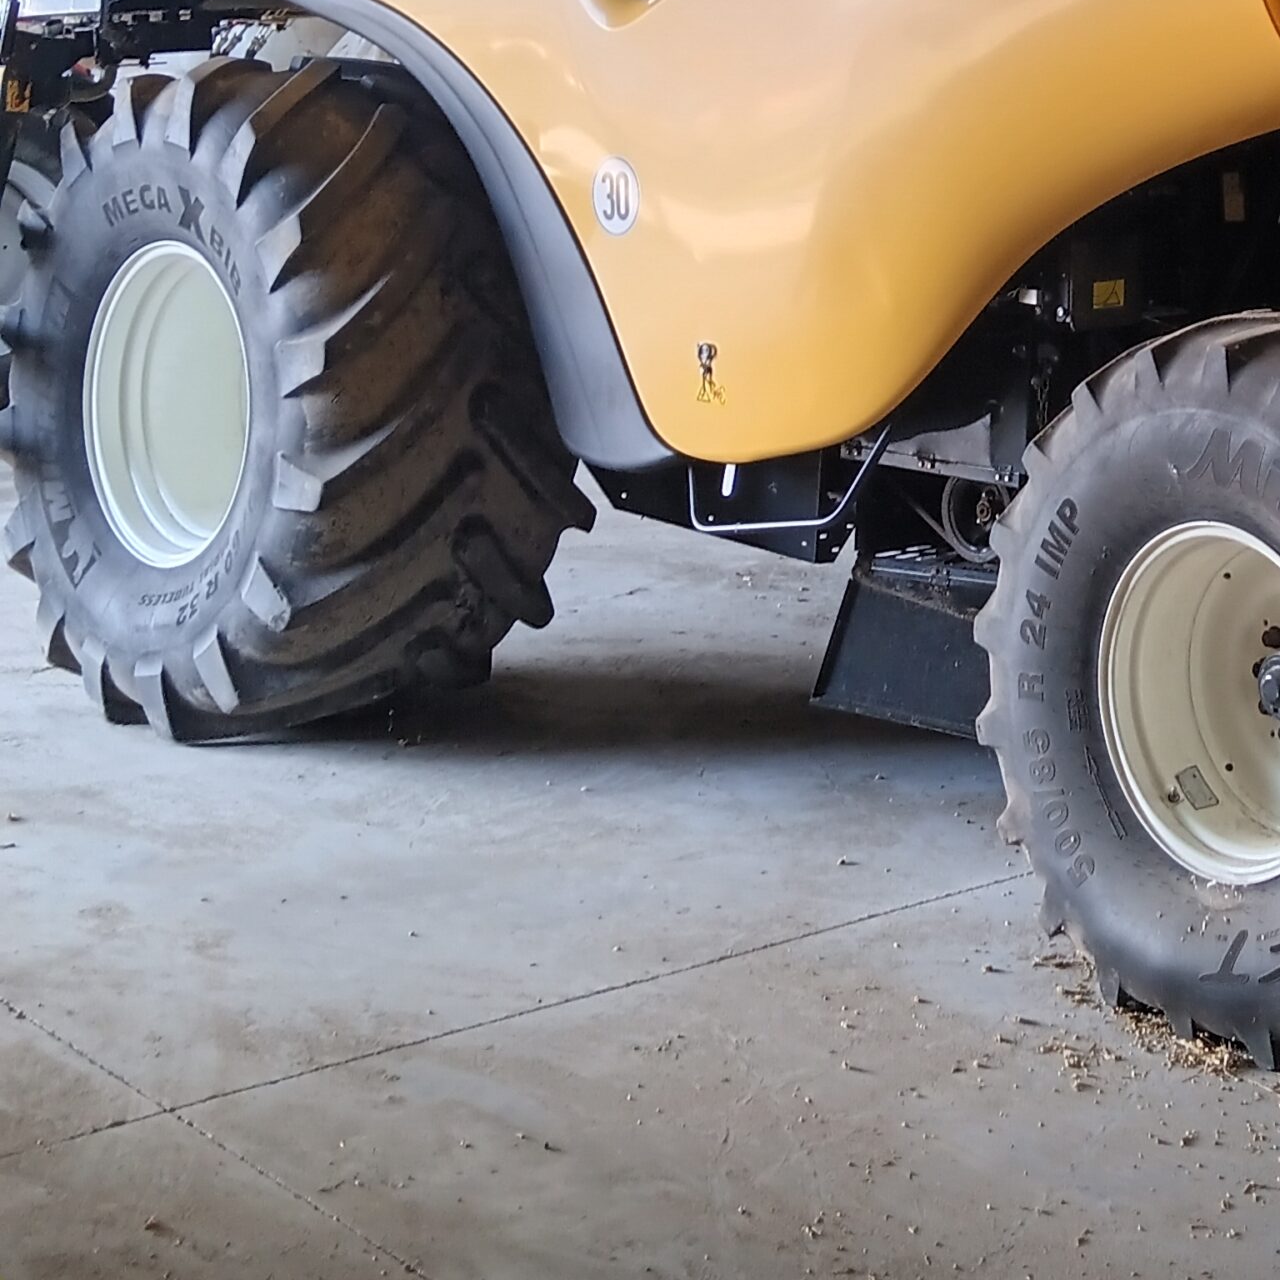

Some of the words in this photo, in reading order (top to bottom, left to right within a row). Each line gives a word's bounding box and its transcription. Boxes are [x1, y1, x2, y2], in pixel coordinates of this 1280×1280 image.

[601, 171, 630, 221] 30
[1034, 496, 1080, 581] IMP
[1019, 588, 1052, 651] 24
[1017, 671, 1045, 703] R
[1023, 727, 1096, 889] 500/85
